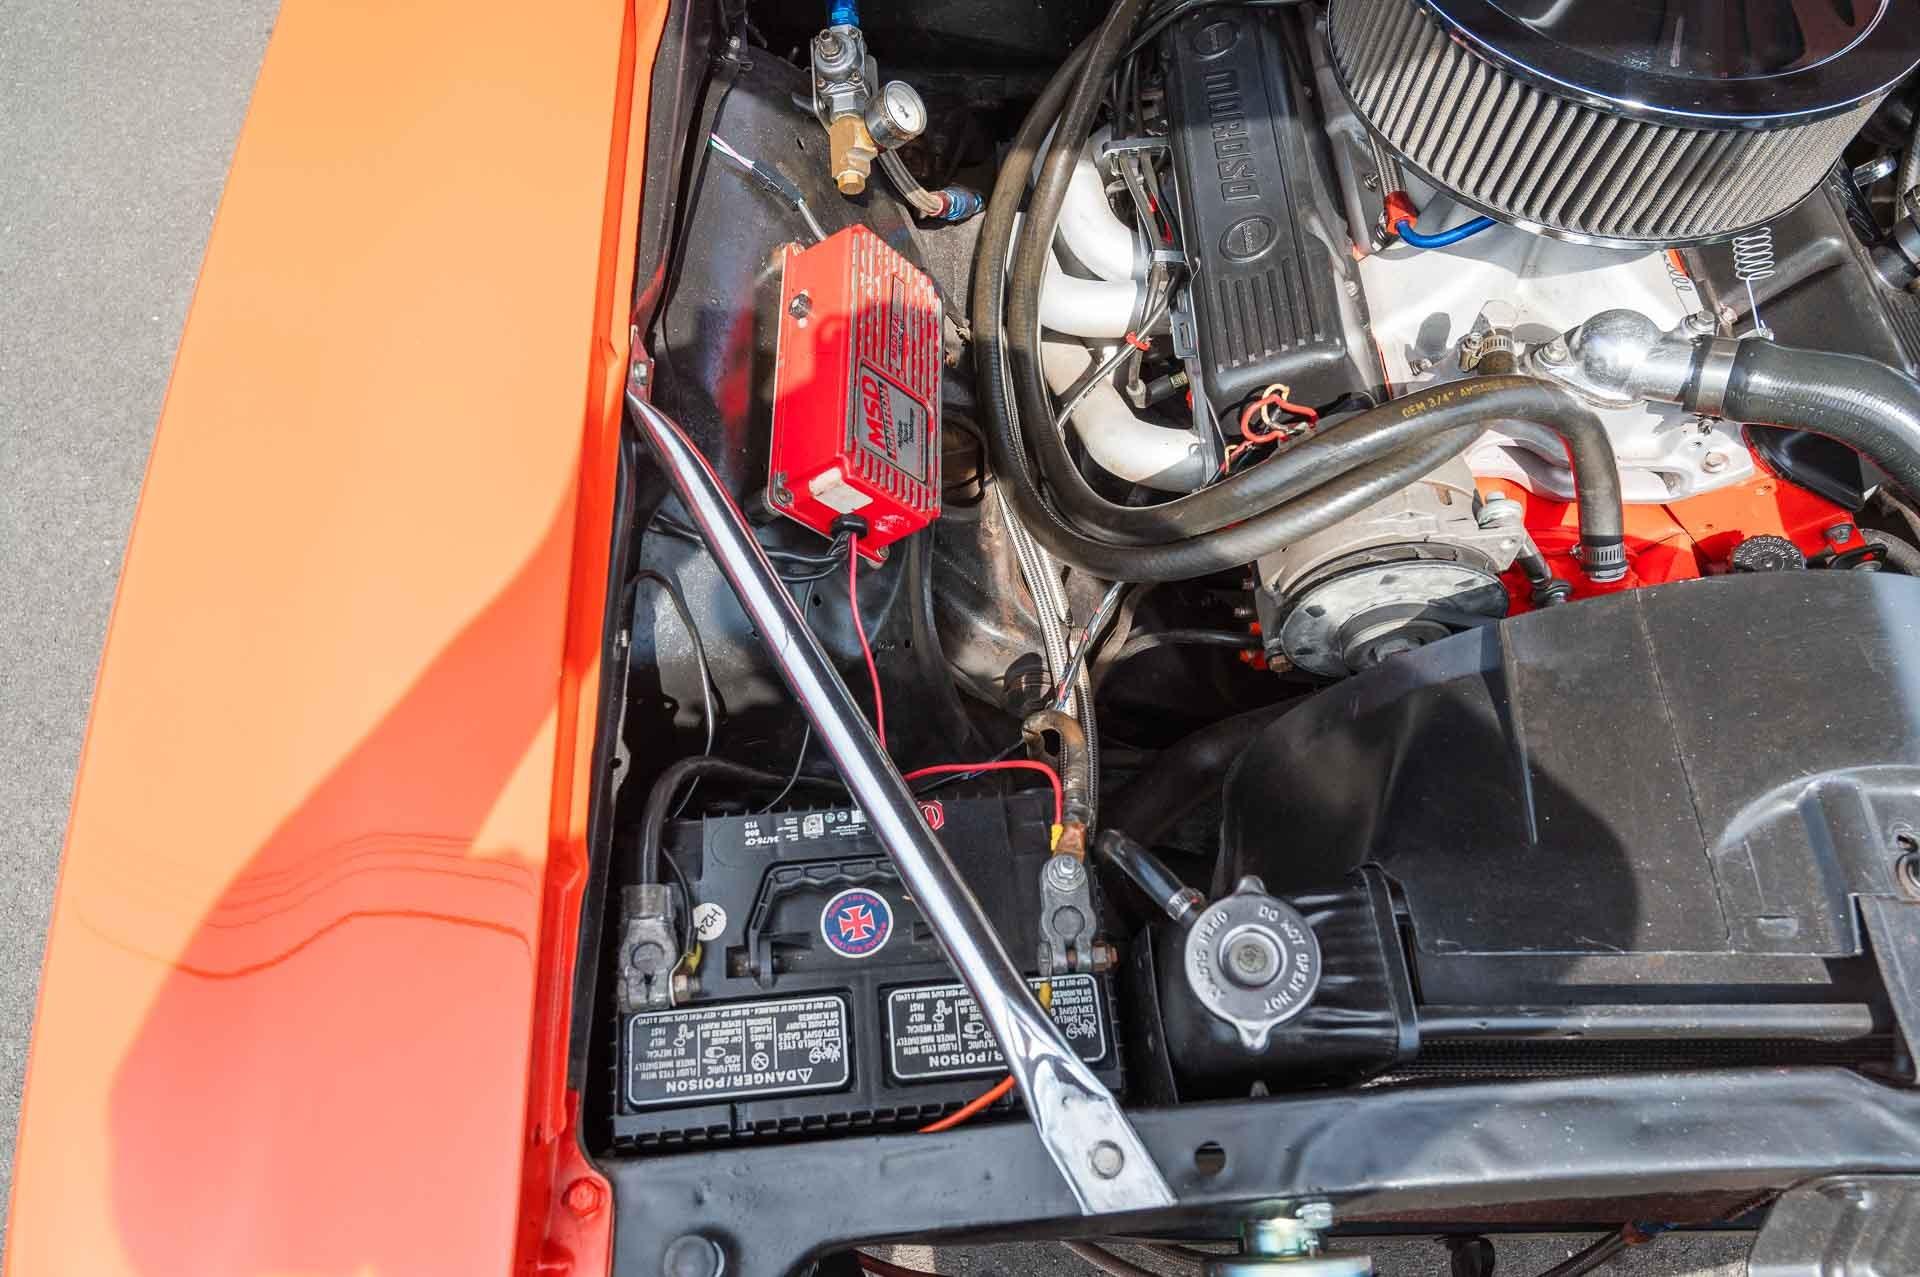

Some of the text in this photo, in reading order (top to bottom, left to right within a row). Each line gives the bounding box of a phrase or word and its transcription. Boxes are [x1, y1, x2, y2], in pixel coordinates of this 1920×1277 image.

[861, 376, 886, 451] MSD
[880, 384, 896, 456] IGNITION
[1401, 400, 1426, 418] OEM
[1258, 905, 1309, 1014] DO NOT OPEN HOT
[665, 1069, 797, 1093] DANGER/POISON
